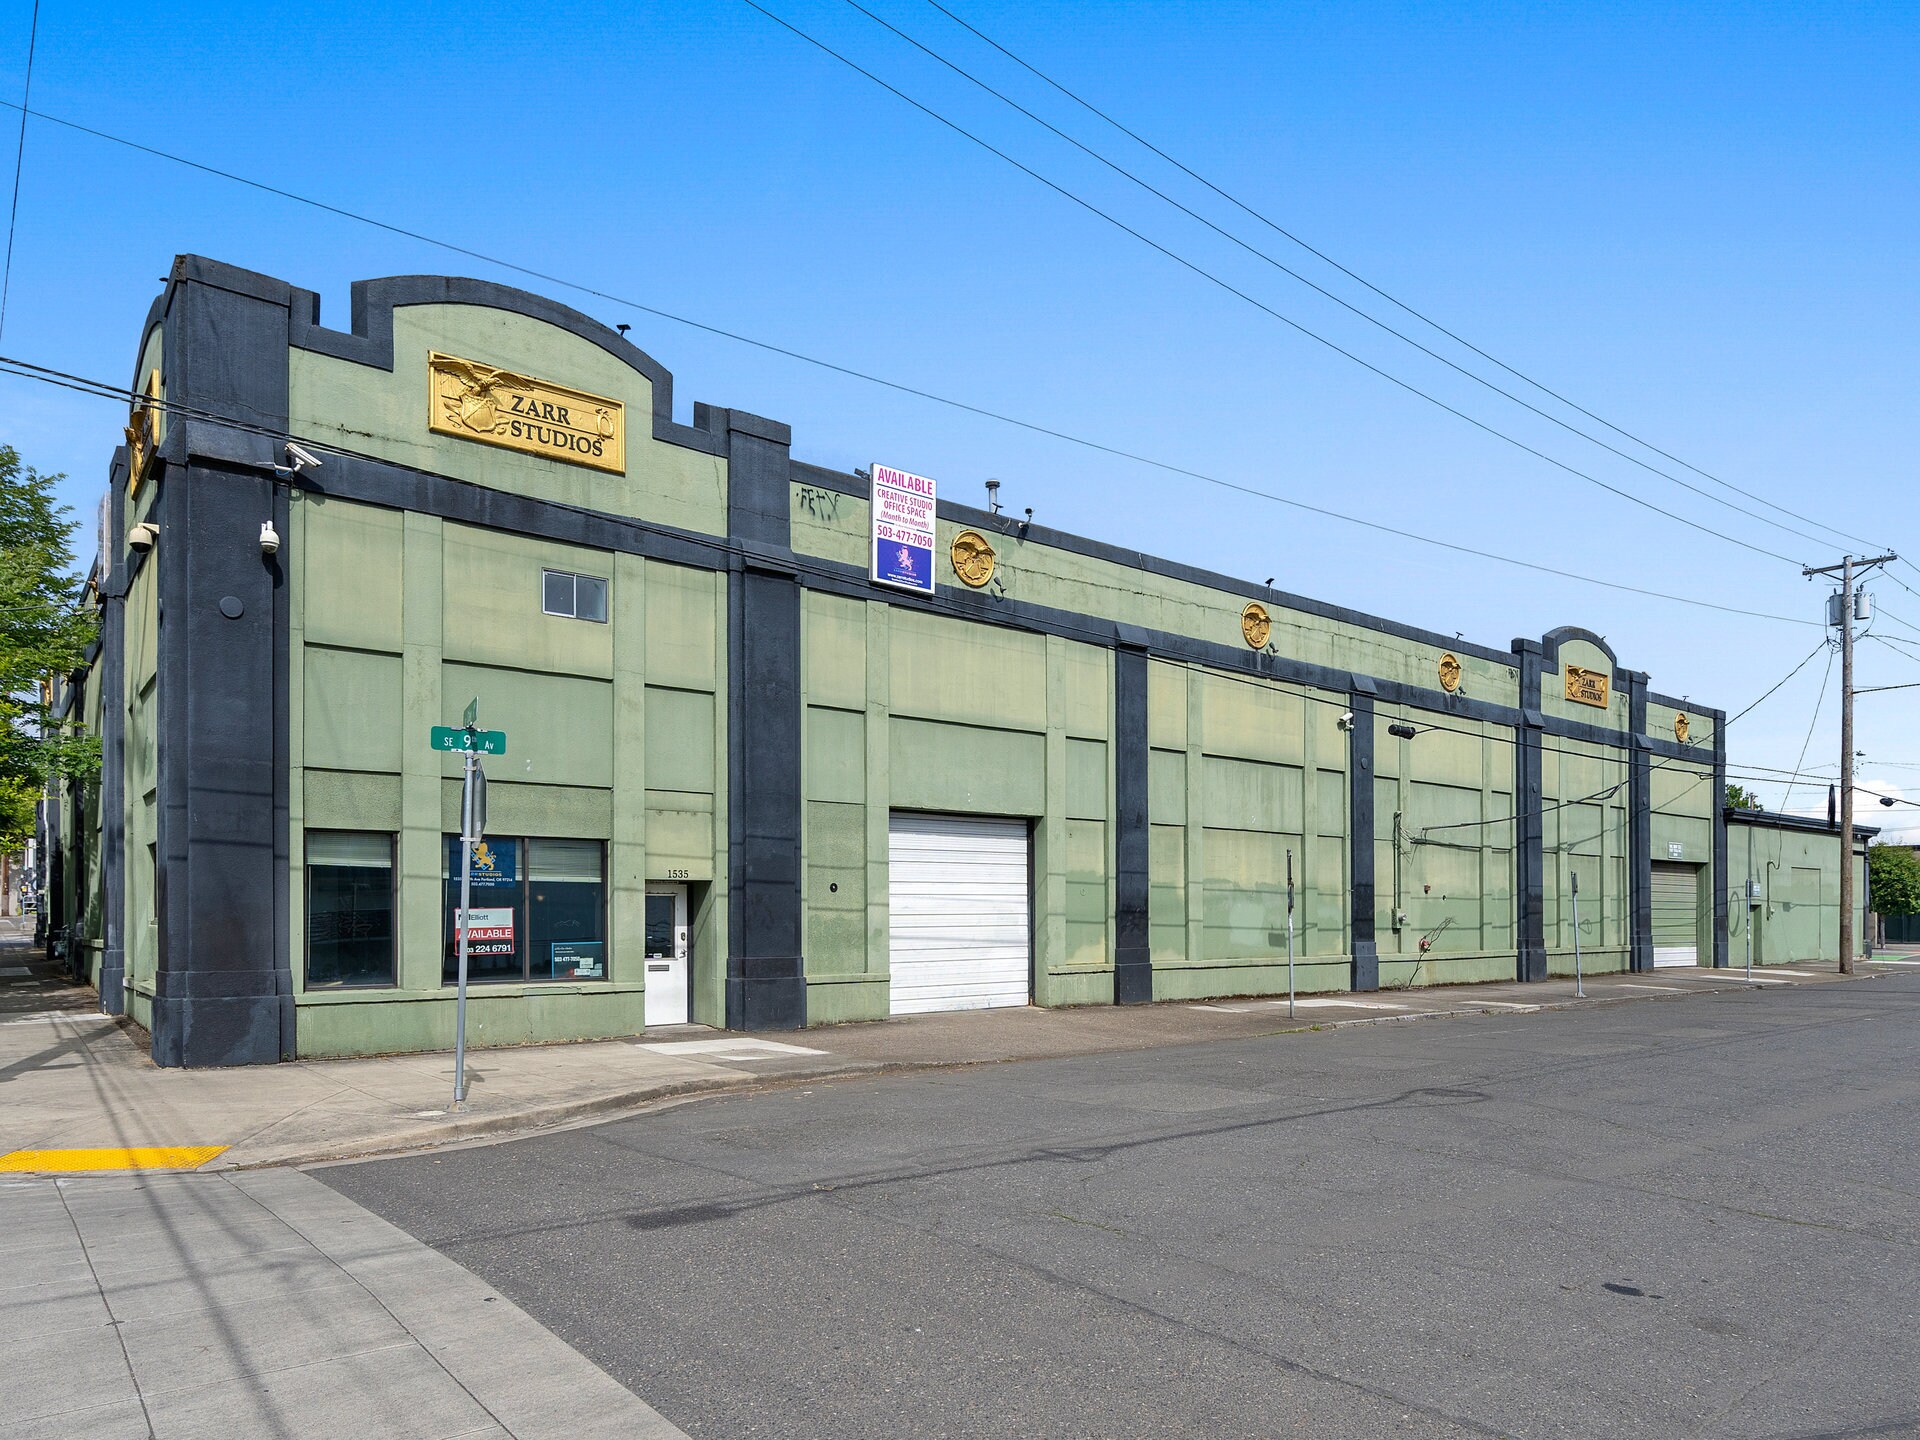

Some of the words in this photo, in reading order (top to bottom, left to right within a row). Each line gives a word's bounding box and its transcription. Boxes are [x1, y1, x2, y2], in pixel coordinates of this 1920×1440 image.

[511, 394, 571, 426] ZARR
[510, 419, 603, 457] STUDIOS
[877, 467, 933, 496] AVAILABLE
[877, 488, 909, 505] CREATIVE
[909, 496, 933, 511] STUDIO
[883, 500, 906, 514] OFFICE
[906, 505, 926, 519] SPACE
[880, 510, 902, 522] (Month
[902, 516, 908, 524] to
[908, 517, 930, 530] Month)
[877, 524, 933, 548] 503-477-7050
[1580, 689, 1603, 702] STUDIOS
[443, 736, 454, 747] SE
[484, 740, 494, 750] Av
[667, 869, 689, 879] 1535
[475, 945, 490, 953] 224
[491, 944, 511, 952] 6791
